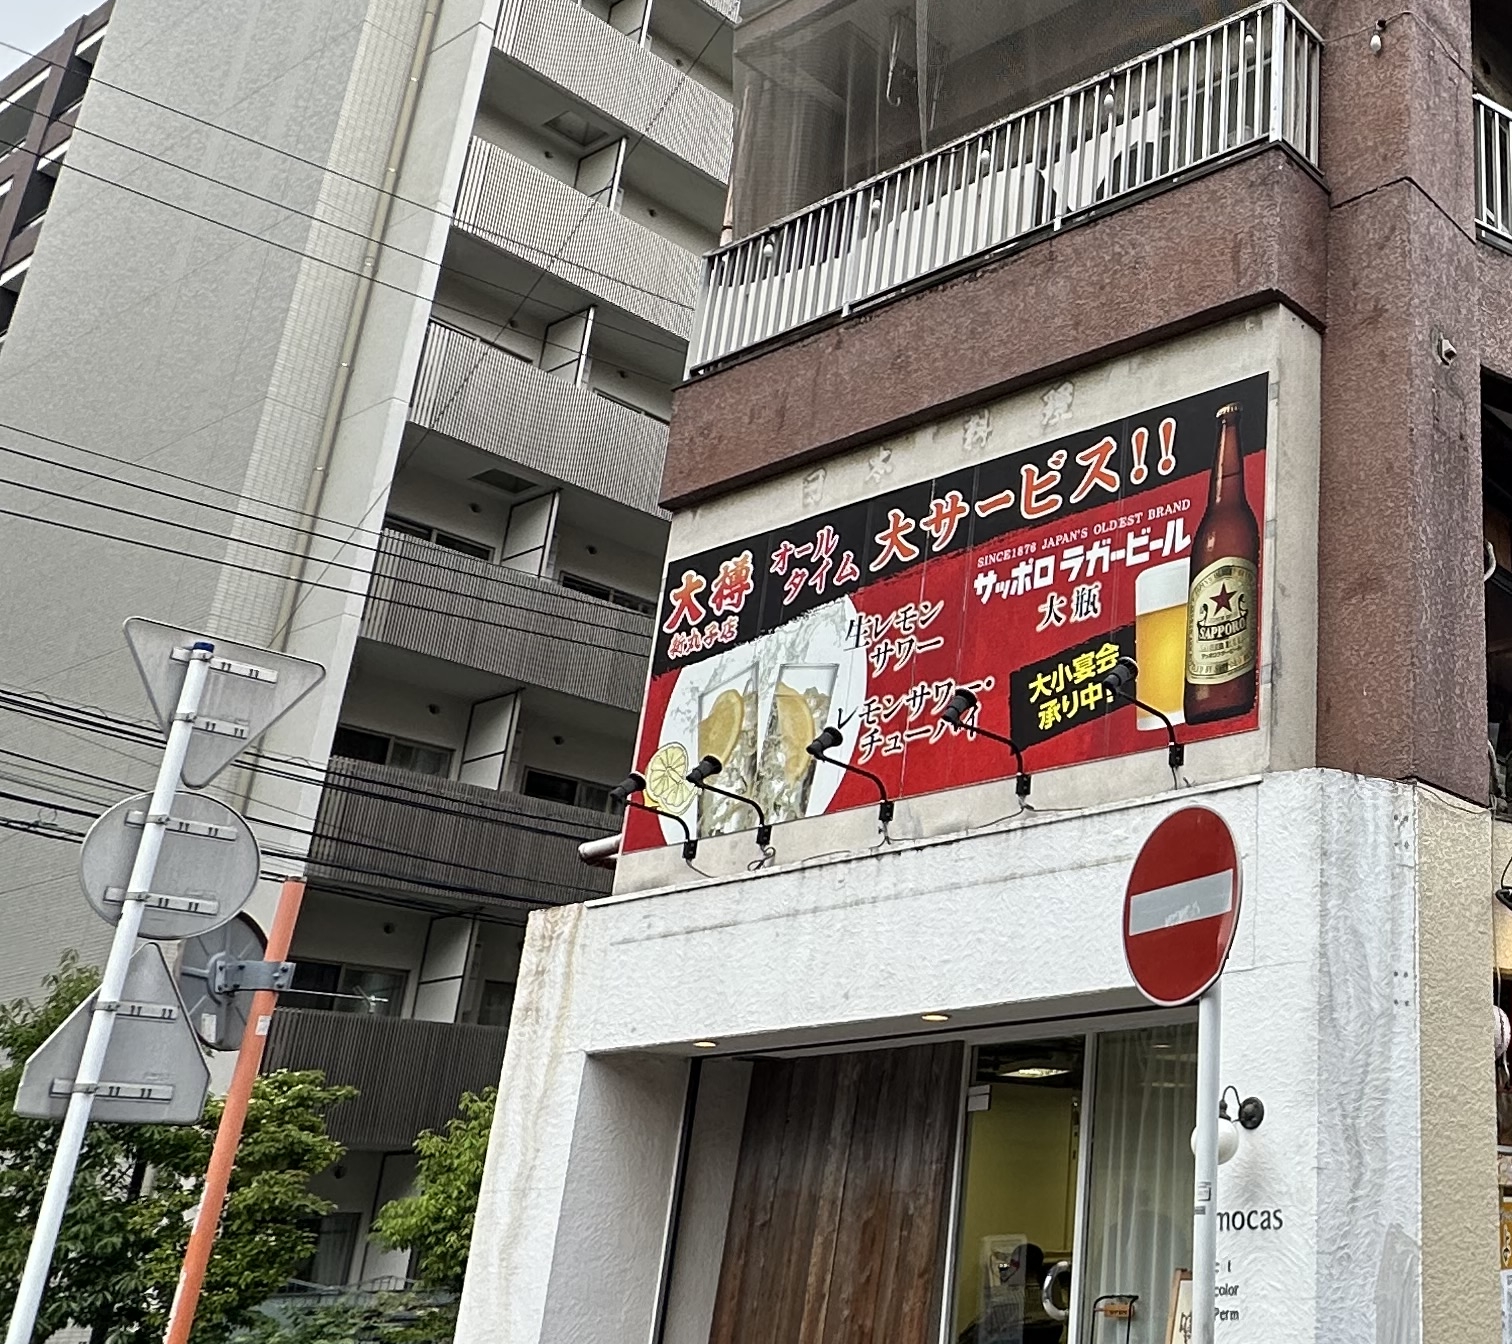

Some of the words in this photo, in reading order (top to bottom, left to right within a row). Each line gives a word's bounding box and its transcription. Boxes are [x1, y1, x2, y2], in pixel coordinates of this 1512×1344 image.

[870, 417, 1177, 572] 大サービス!!
[1041, 526, 1088, 549] JAPAN'S
[1093, 512, 1143, 535] OLDEST
[1147, 498, 1191, 520] BRAND
[770, 525, 839, 575] オール
[974, 555, 1055, 604] サッポロ
[1060, 518, 1192, 582] ラガービール
[663, 550, 754, 634] 大樽
[783, 551, 860, 606] タイム
[844, 599, 945, 652] 生レモン
[1036, 582, 1101, 632] 大瓶
[1200, 618, 1247, 640] SAPPORO
[668, 616, 740, 659] 新丸子店
[870, 636, 945, 678] サワー
[1028, 642, 1120, 704] 大小宴会
